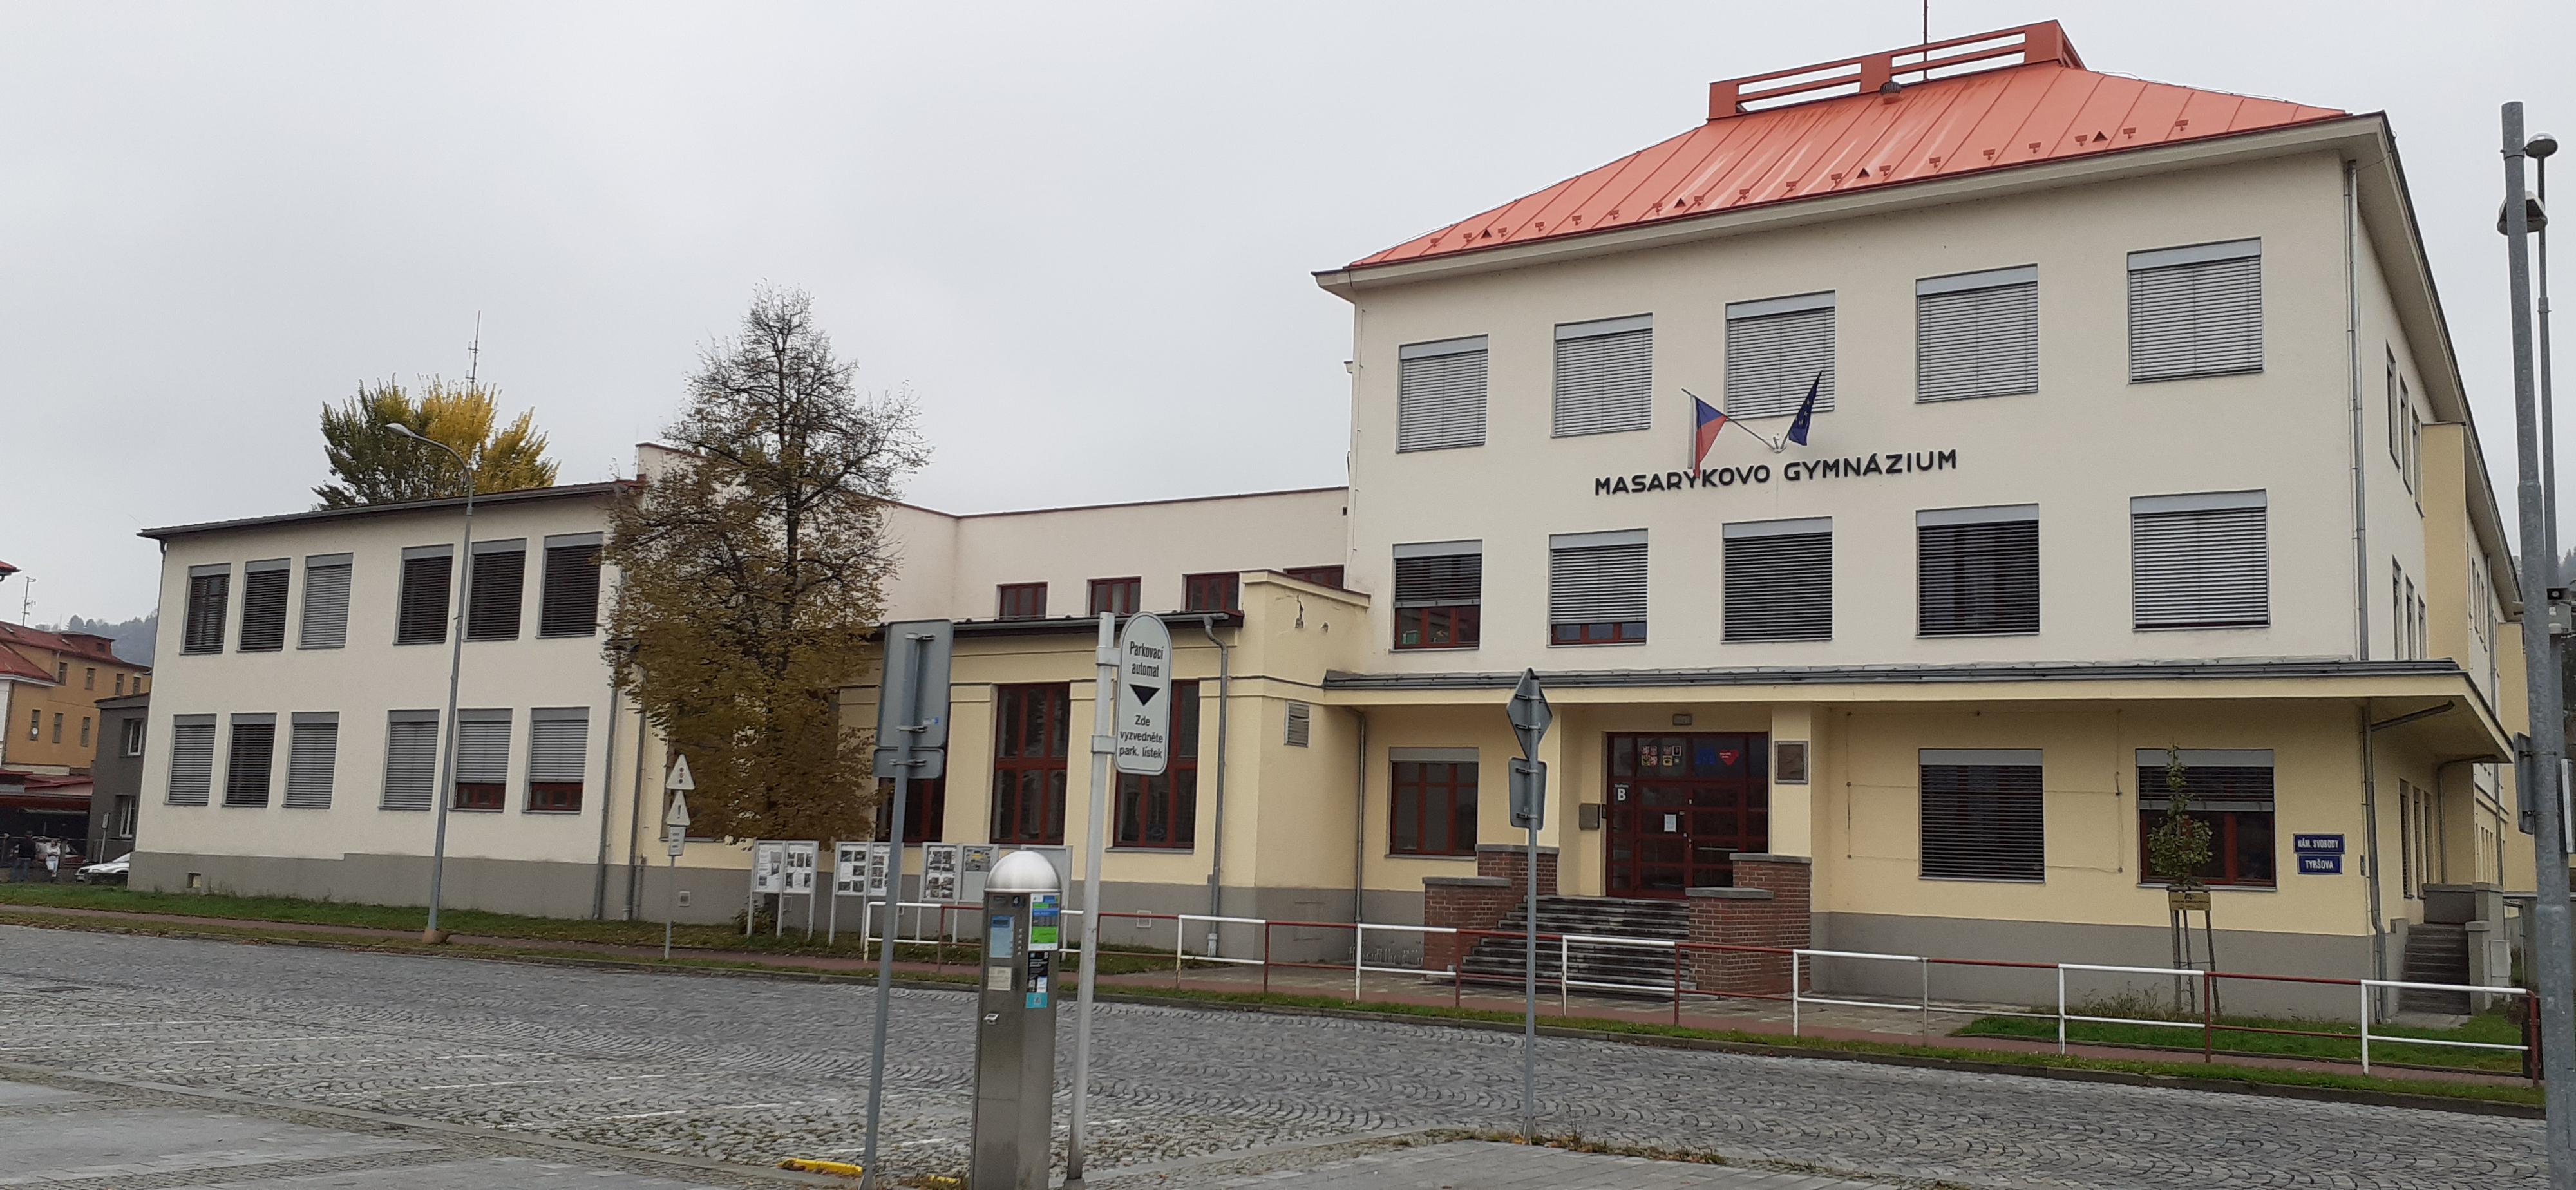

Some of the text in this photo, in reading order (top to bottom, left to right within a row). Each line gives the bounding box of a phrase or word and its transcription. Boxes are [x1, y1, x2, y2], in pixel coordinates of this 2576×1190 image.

[1595, 449, 1956, 496] MASARYKOVO GYMNÁZIUM
[1130, 641, 1164, 659] Parkovací
[1132, 662, 1159, 677] automat
[1135, 714, 1150, 726] Zde
[1120, 731, 1163, 743] vyzvedněte
[1119, 746, 1162, 759] park. lístek
[1618, 788, 1626, 801] B
[2298, 837, 2339, 848] NÁM. SVOBODY
[2305, 858, 2334, 869] TYRŠOVA
